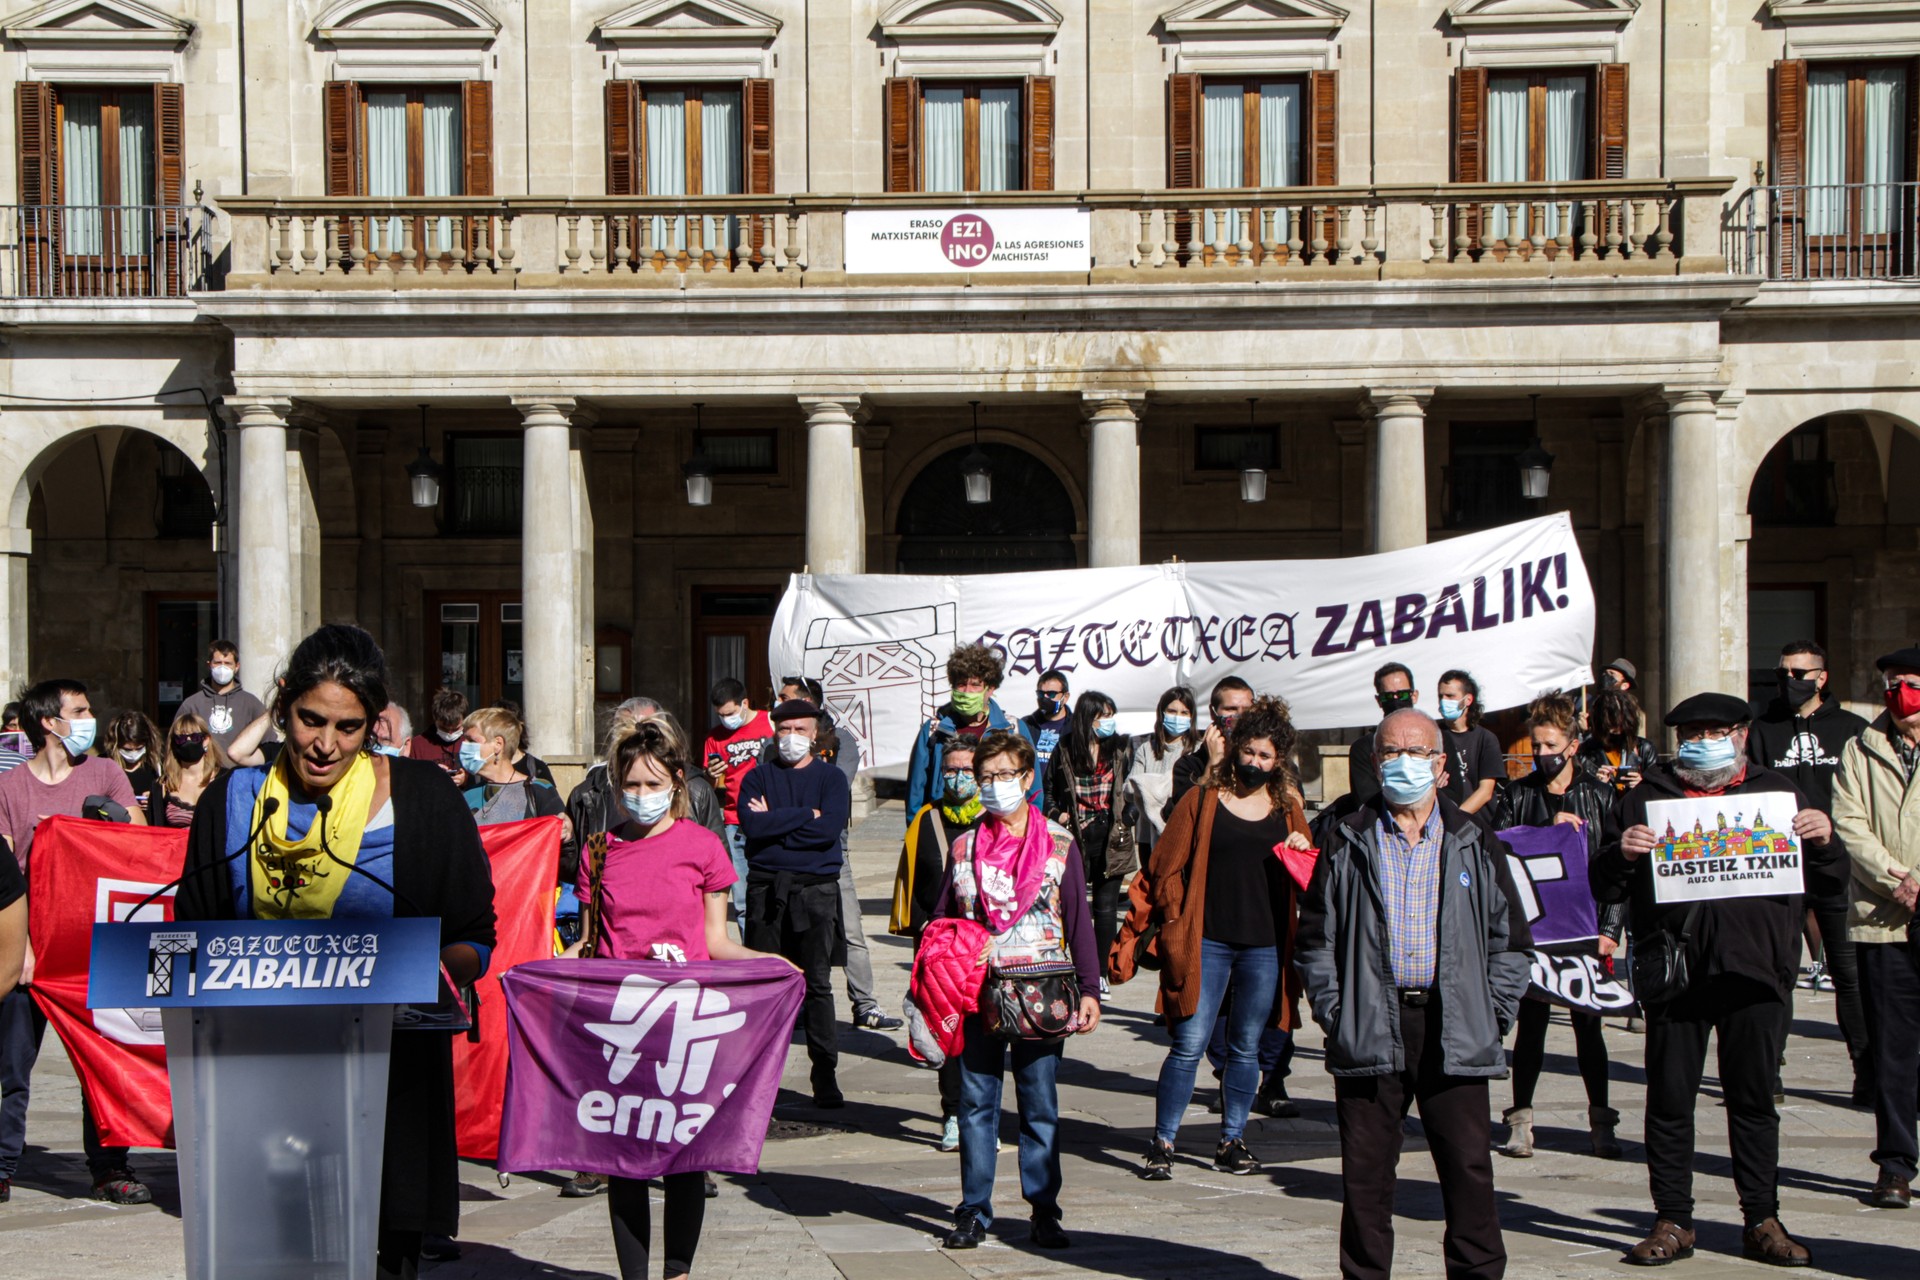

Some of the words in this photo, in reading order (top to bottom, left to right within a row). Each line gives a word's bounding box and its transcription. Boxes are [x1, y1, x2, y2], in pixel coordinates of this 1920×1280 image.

[910, 219, 943, 228] ERASO
[952, 221, 982, 237] EZ!
[871, 232, 939, 240] MATXISTARIK
[995, 241, 1001, 249] A
[1005, 241, 1021, 249] LAS
[1024, 240, 1084, 249] AGRESIONES
[992, 252, 1049, 261] MACHISTAS!
[1311, 552, 1569, 657] ZABALIK!
[1657, 857, 1738, 877] GASTEIZ
[1745, 854, 1798, 870] TXIKI
[1687, 875, 1715, 884] AUZO
[1720, 872, 1774, 881] ELKARTEA
[206, 933, 379, 957] GAZTETXEA
[201, 956, 377, 990] ZABALIK!
[577, 1083, 737, 1145] erna
